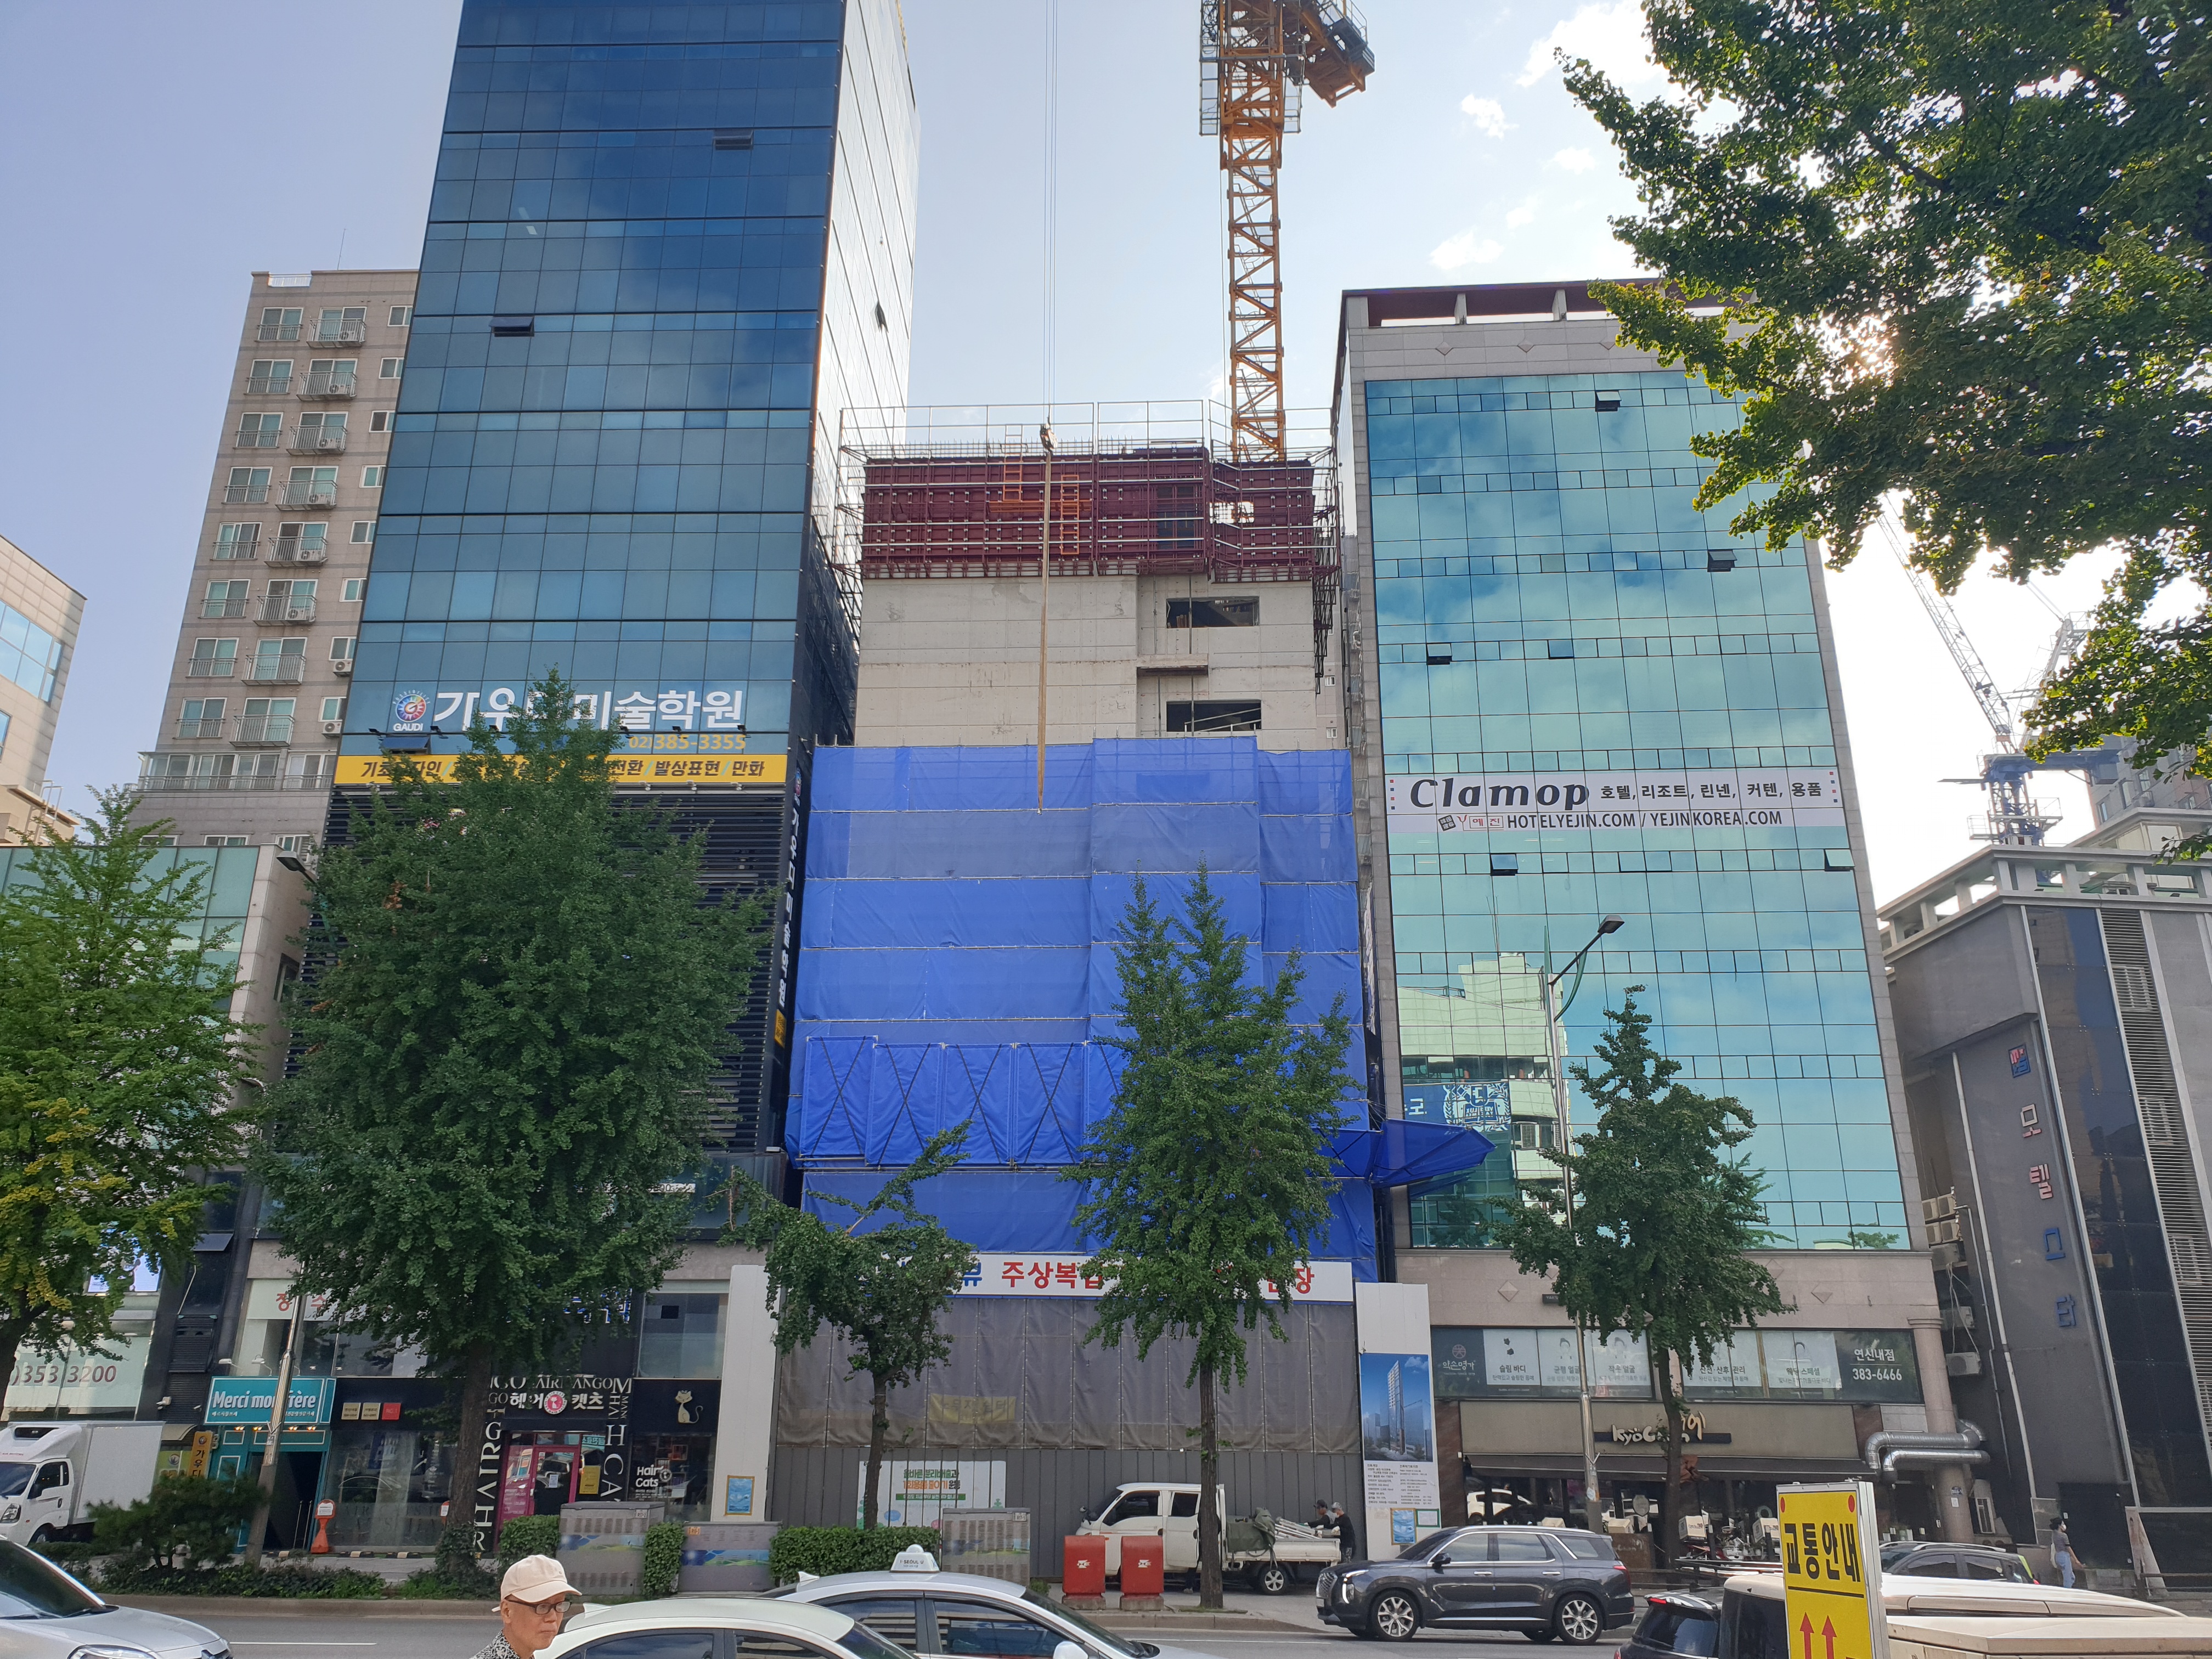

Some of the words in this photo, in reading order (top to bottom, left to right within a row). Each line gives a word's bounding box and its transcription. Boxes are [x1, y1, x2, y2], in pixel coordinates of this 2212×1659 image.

[393, 723, 424, 731] GAUDI
[629, 734, 747, 750] 02)385-3355
[361, 760, 442, 779] 기초자인
[654, 760, 721, 778] 발상표현
[732, 761, 765, 777] 만화
[1410, 777, 1590, 811] Clamop
[1600, 785, 1637, 800] 호텔,
[1641, 785, 1695, 800] 리조트,
[1700, 784, 1736, 800] 린넨,
[1747, 783, 1784, 799] 커텐,
[1791, 782, 1822, 798] 용품
[1507, 814, 1637, 828] HOTELYEJIN.COM
[1650, 812, 1782, 827] YEJINKOREA.COM
[1854, 1348, 1895, 1362] 연신내점
[1442, 1359, 1475, 1371] 약손명가
[1513, 1364, 1526, 1373] 바디
[67, 1365, 117, 1383] 3200
[1852, 1368, 1903, 1381] 383-6466
[212, 1390, 251, 1409] Merci
[572, 1391, 605, 1410] 캣츠
[636, 1464, 664, 1476] Hair
[635, 1477, 659, 1488] Cats
[1784, 1522, 1861, 1583] 교통안내
